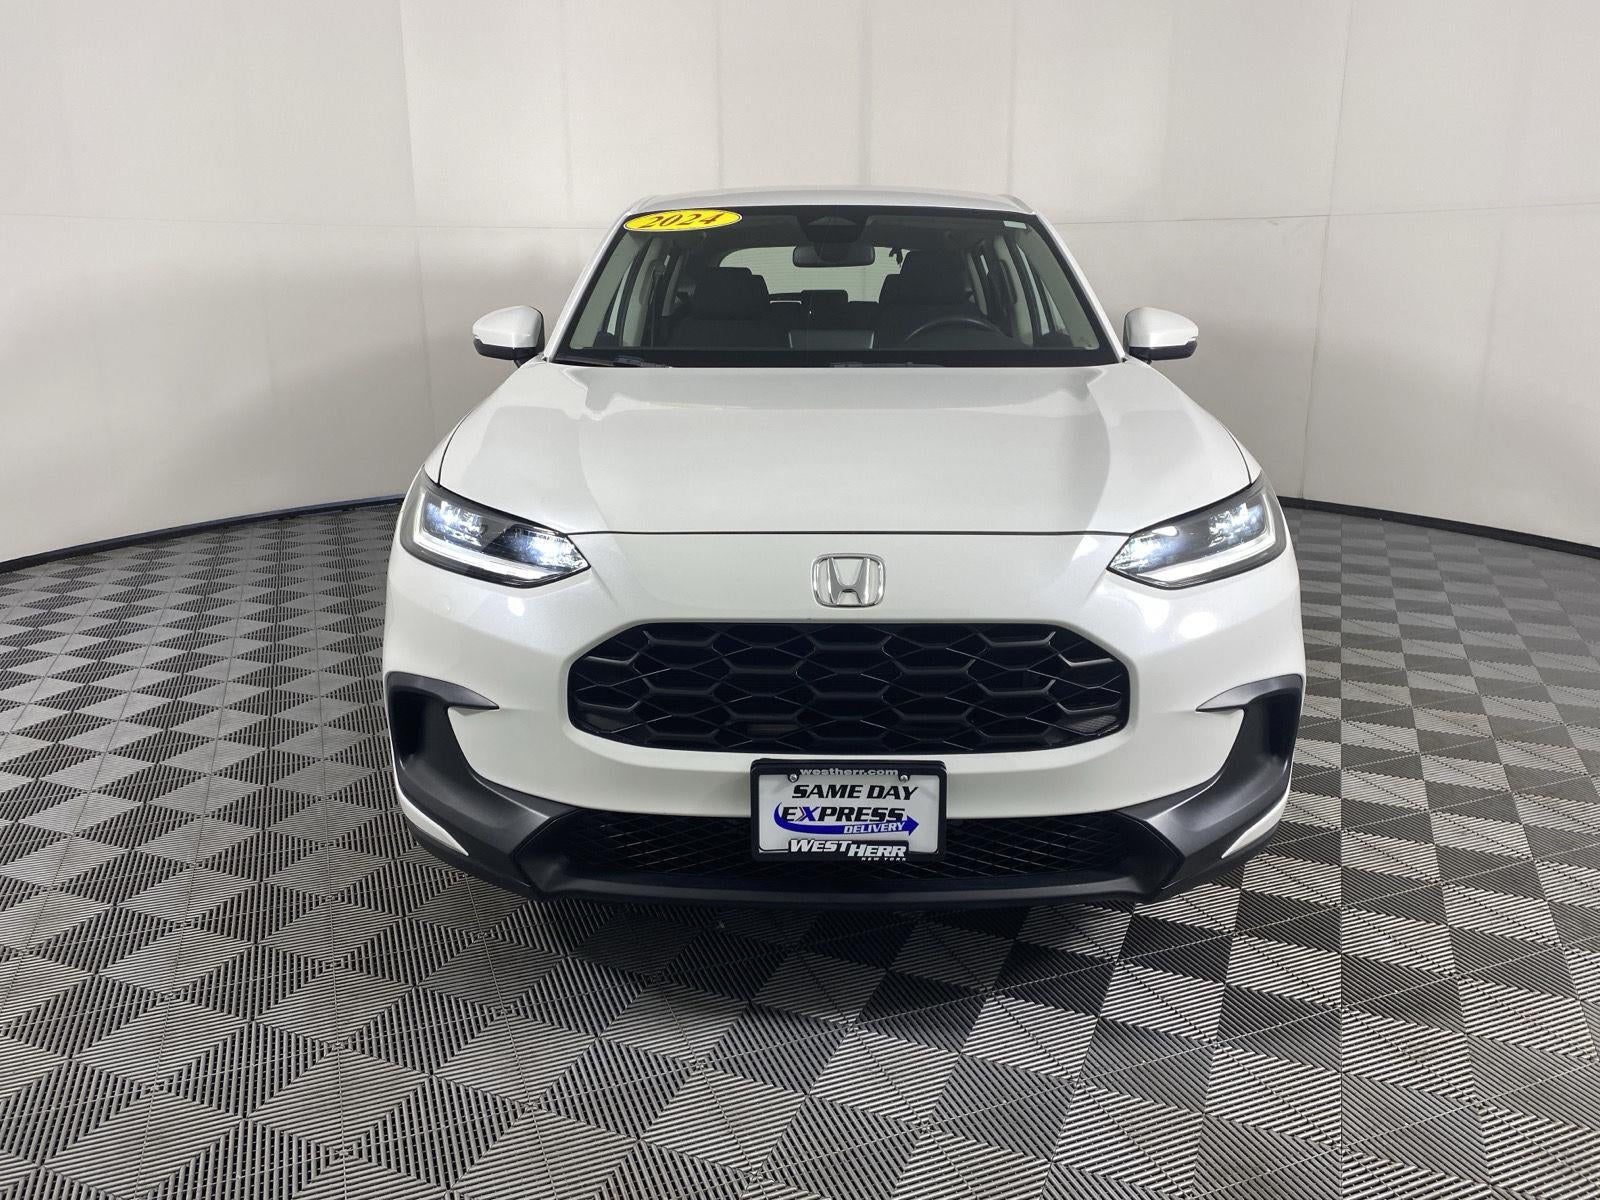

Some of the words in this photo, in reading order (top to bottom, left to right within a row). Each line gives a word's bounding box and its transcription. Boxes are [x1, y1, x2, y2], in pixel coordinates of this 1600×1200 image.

[638, 213, 725, 229] 2024
[800, 768, 899, 776] westherr.com
[792, 784, 862, 799] SAME
[867, 784, 919, 800] DAY
[781, 806, 906, 822] EXPRESS
[843, 821, 906, 834] DELIVERY
